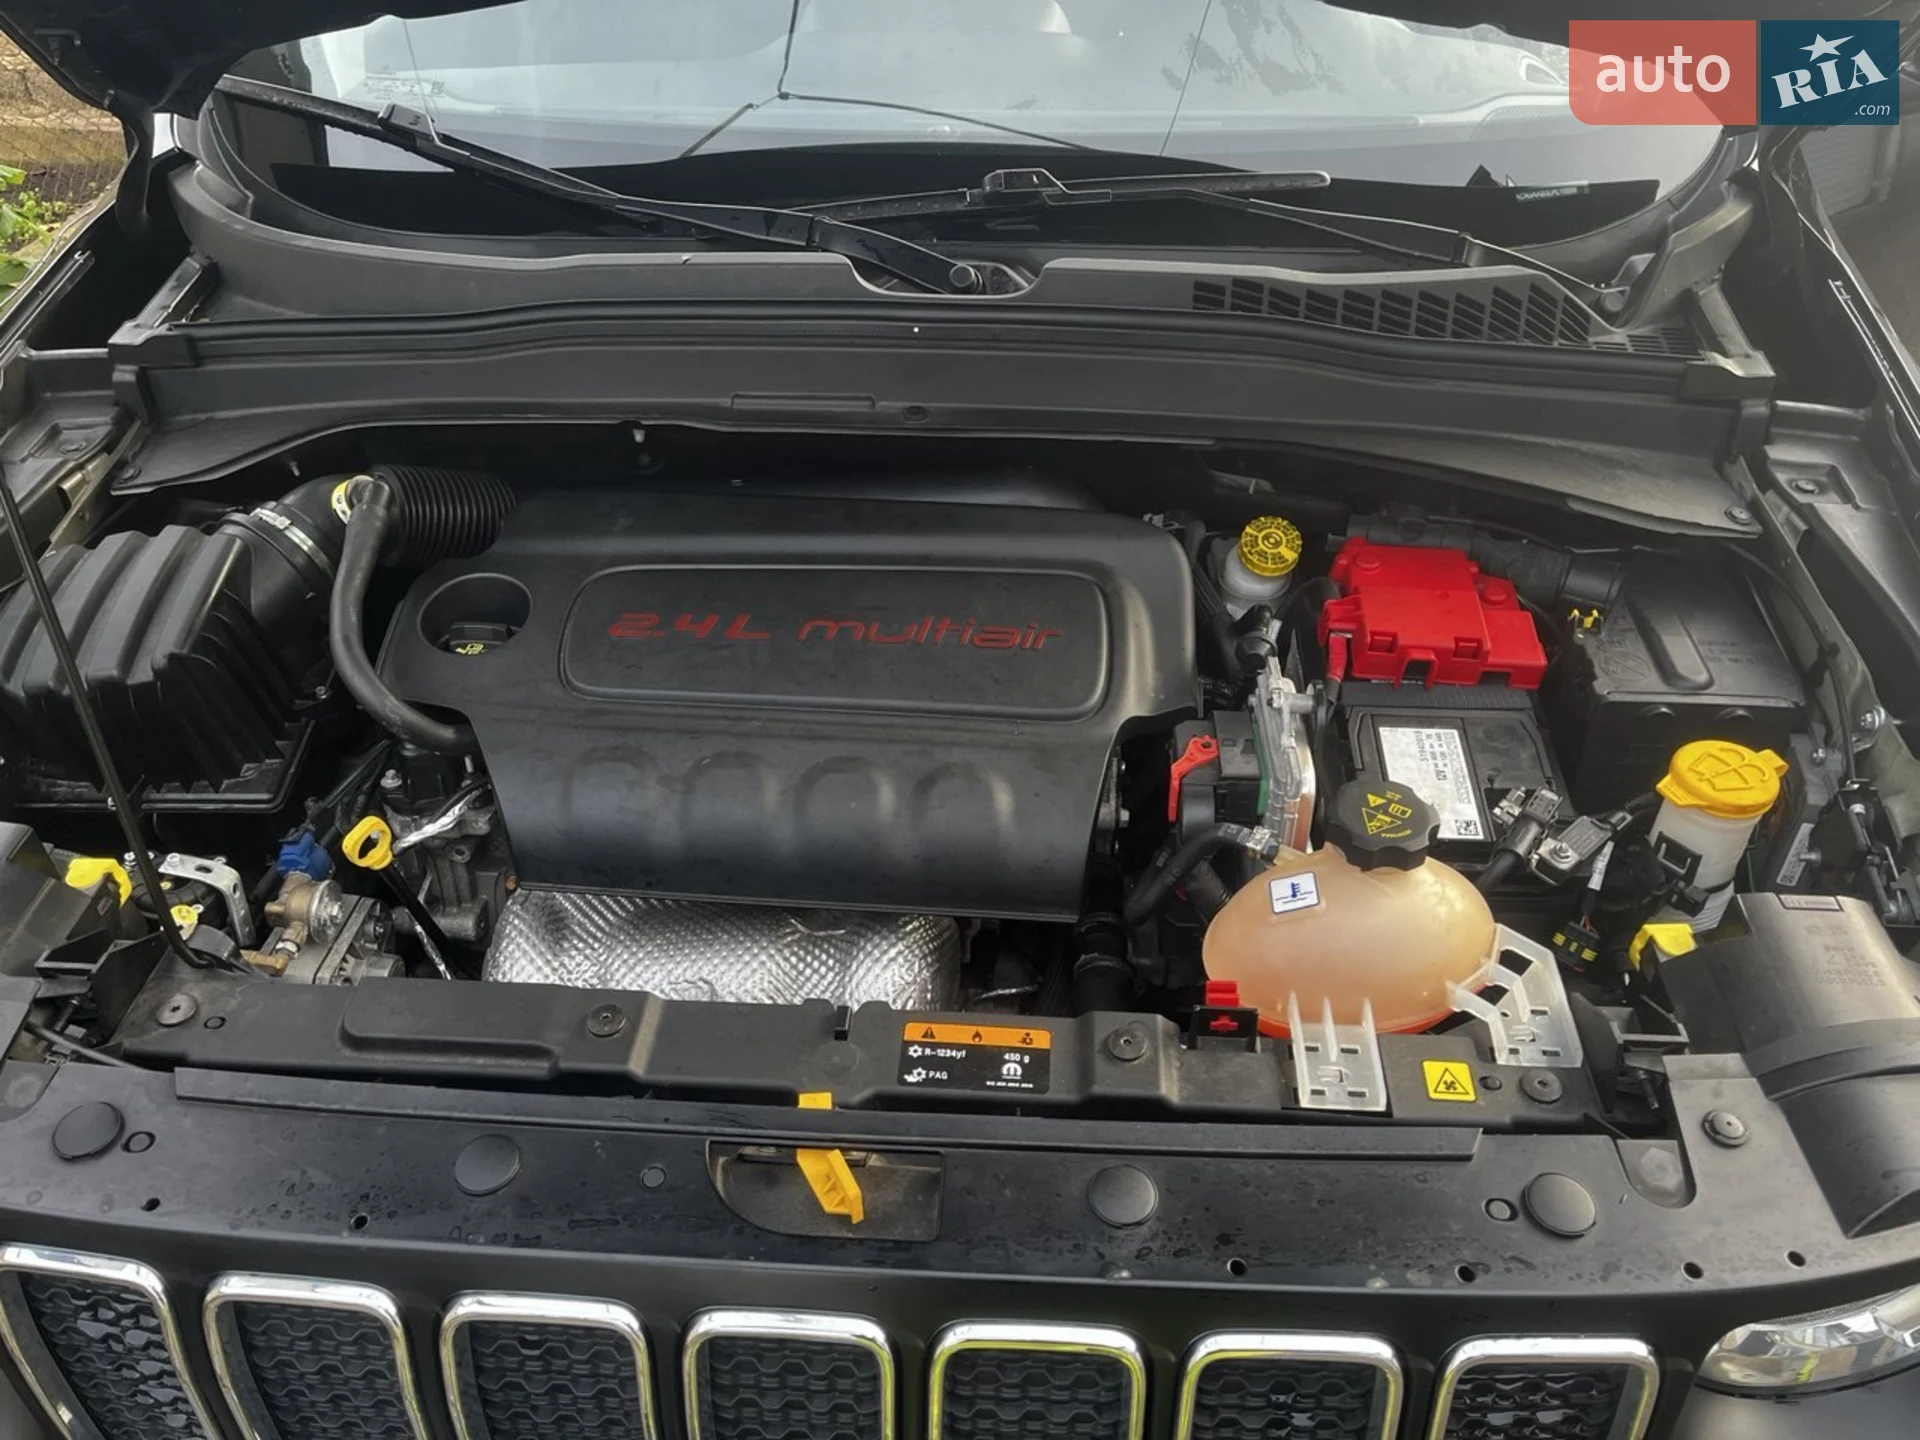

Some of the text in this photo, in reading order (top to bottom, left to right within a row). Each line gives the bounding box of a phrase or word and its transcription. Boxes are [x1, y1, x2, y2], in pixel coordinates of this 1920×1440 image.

[797, 614, 1064, 650] multiair
[924, 1047, 966, 1060] R-1234yf
[1003, 1052, 1021, 1062] 450
[928, 1070, 948, 1080] PAG
